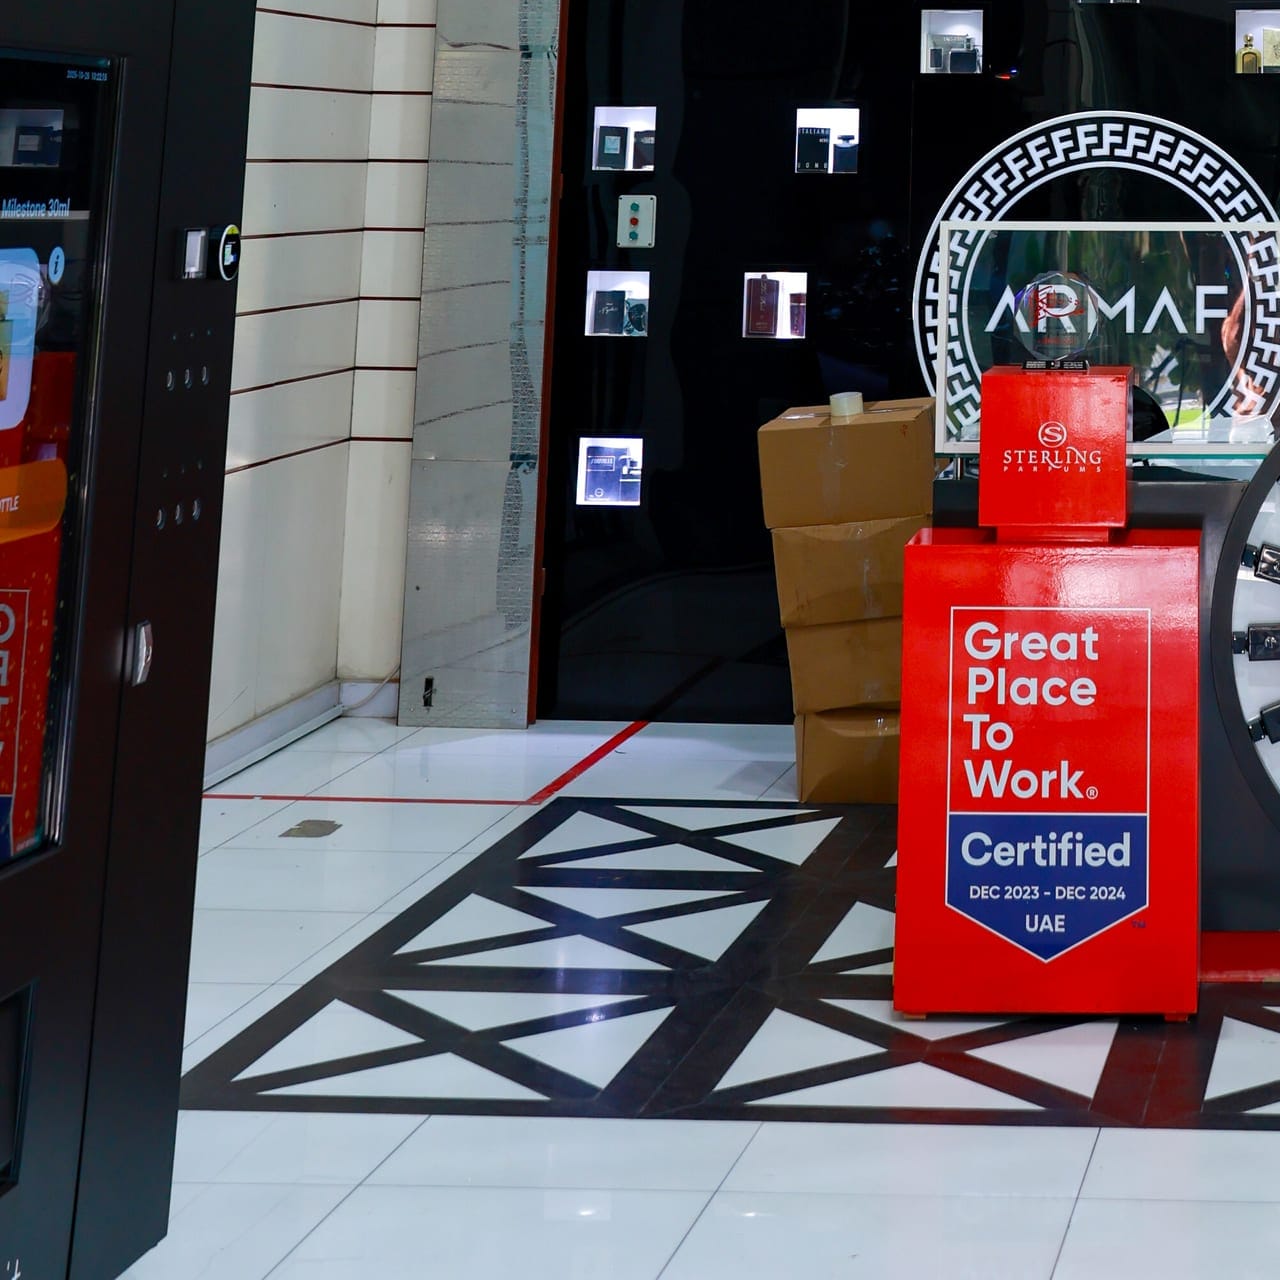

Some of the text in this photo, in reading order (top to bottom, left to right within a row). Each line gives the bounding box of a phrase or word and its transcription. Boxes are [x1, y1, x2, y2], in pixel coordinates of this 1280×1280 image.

[1, 197, 71, 219] Milestone 30ml
[984, 284, 1229, 335] ARMAF
[1003, 446, 1102, 469] STERLING
[964, 621, 1099, 661] Great
[967, 666, 1097, 706] Place
[963, 713, 1014, 751] To
[961, 831, 1131, 867] Certified
[969, 885, 1001, 900] DEC
[1004, 885, 1040, 900] 2023
[1055, 886, 1086, 900] DEC
[1089, 886, 1127, 901] 2024
[1025, 914, 1066, 933] UAE
